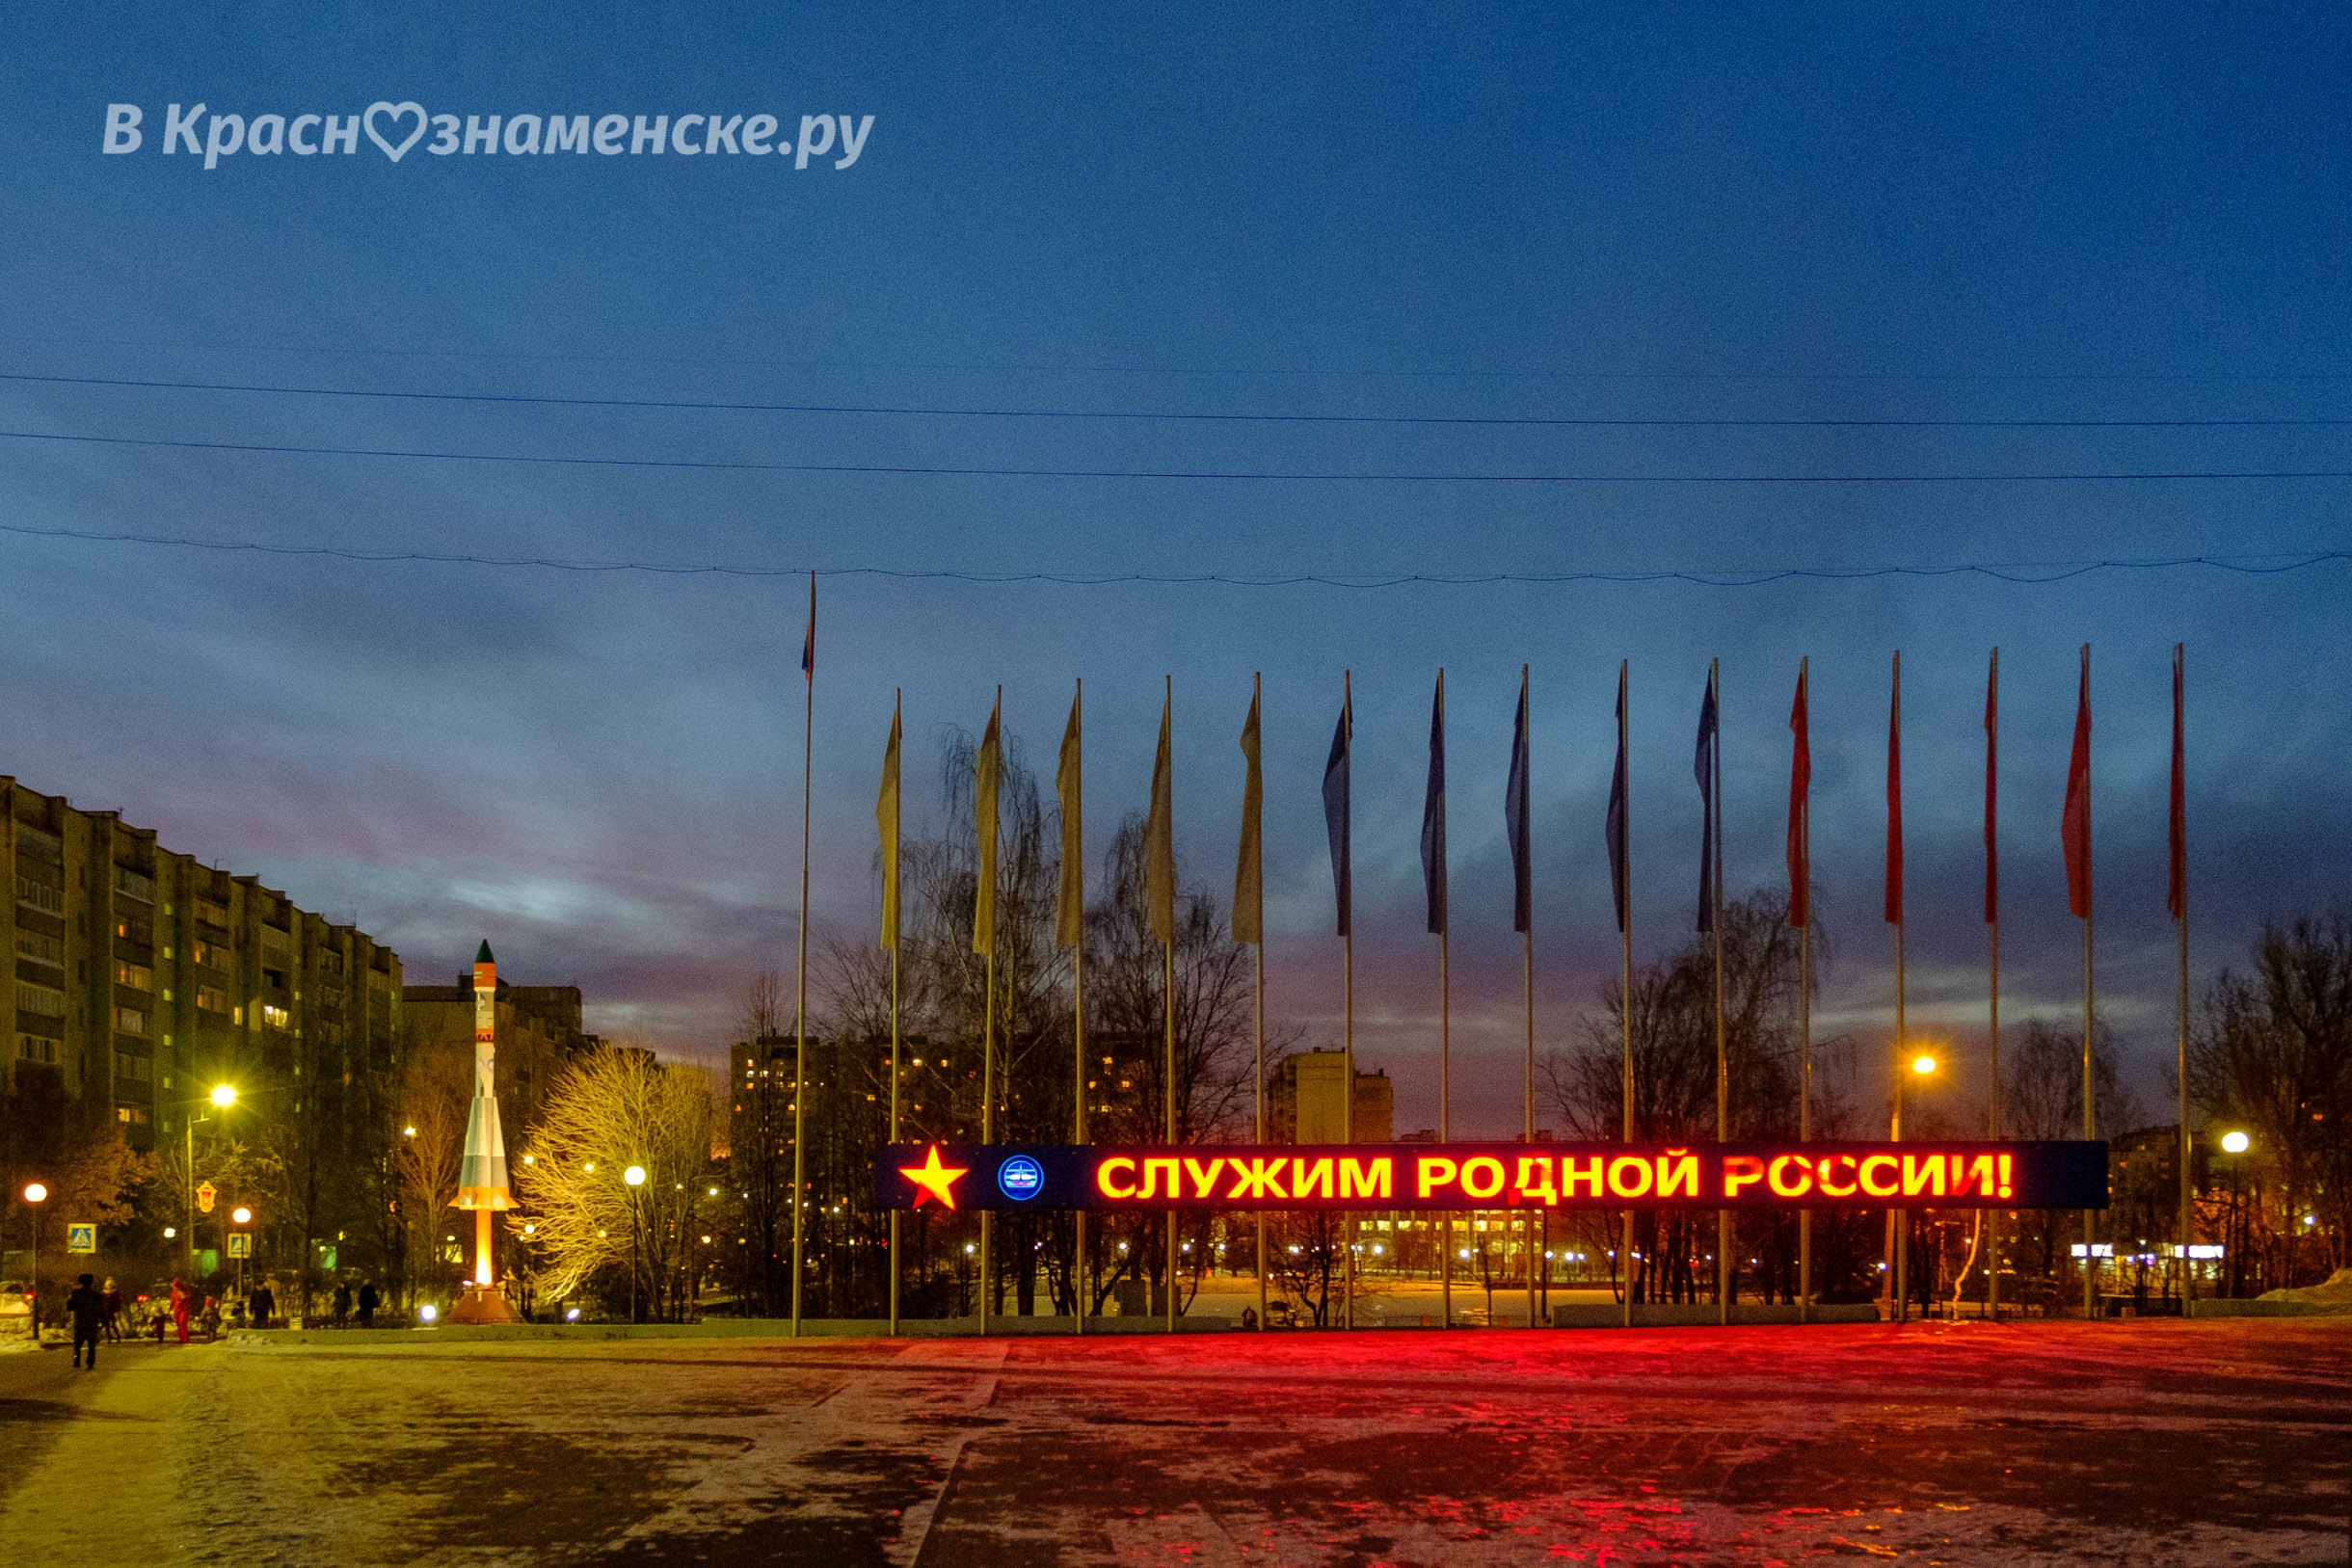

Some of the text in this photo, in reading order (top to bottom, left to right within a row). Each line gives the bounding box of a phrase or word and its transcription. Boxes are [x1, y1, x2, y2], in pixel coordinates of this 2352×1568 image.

[1097, 1148, 2013, 1206] СЛУЖИМ РОДНОЙ РОССИИ!
